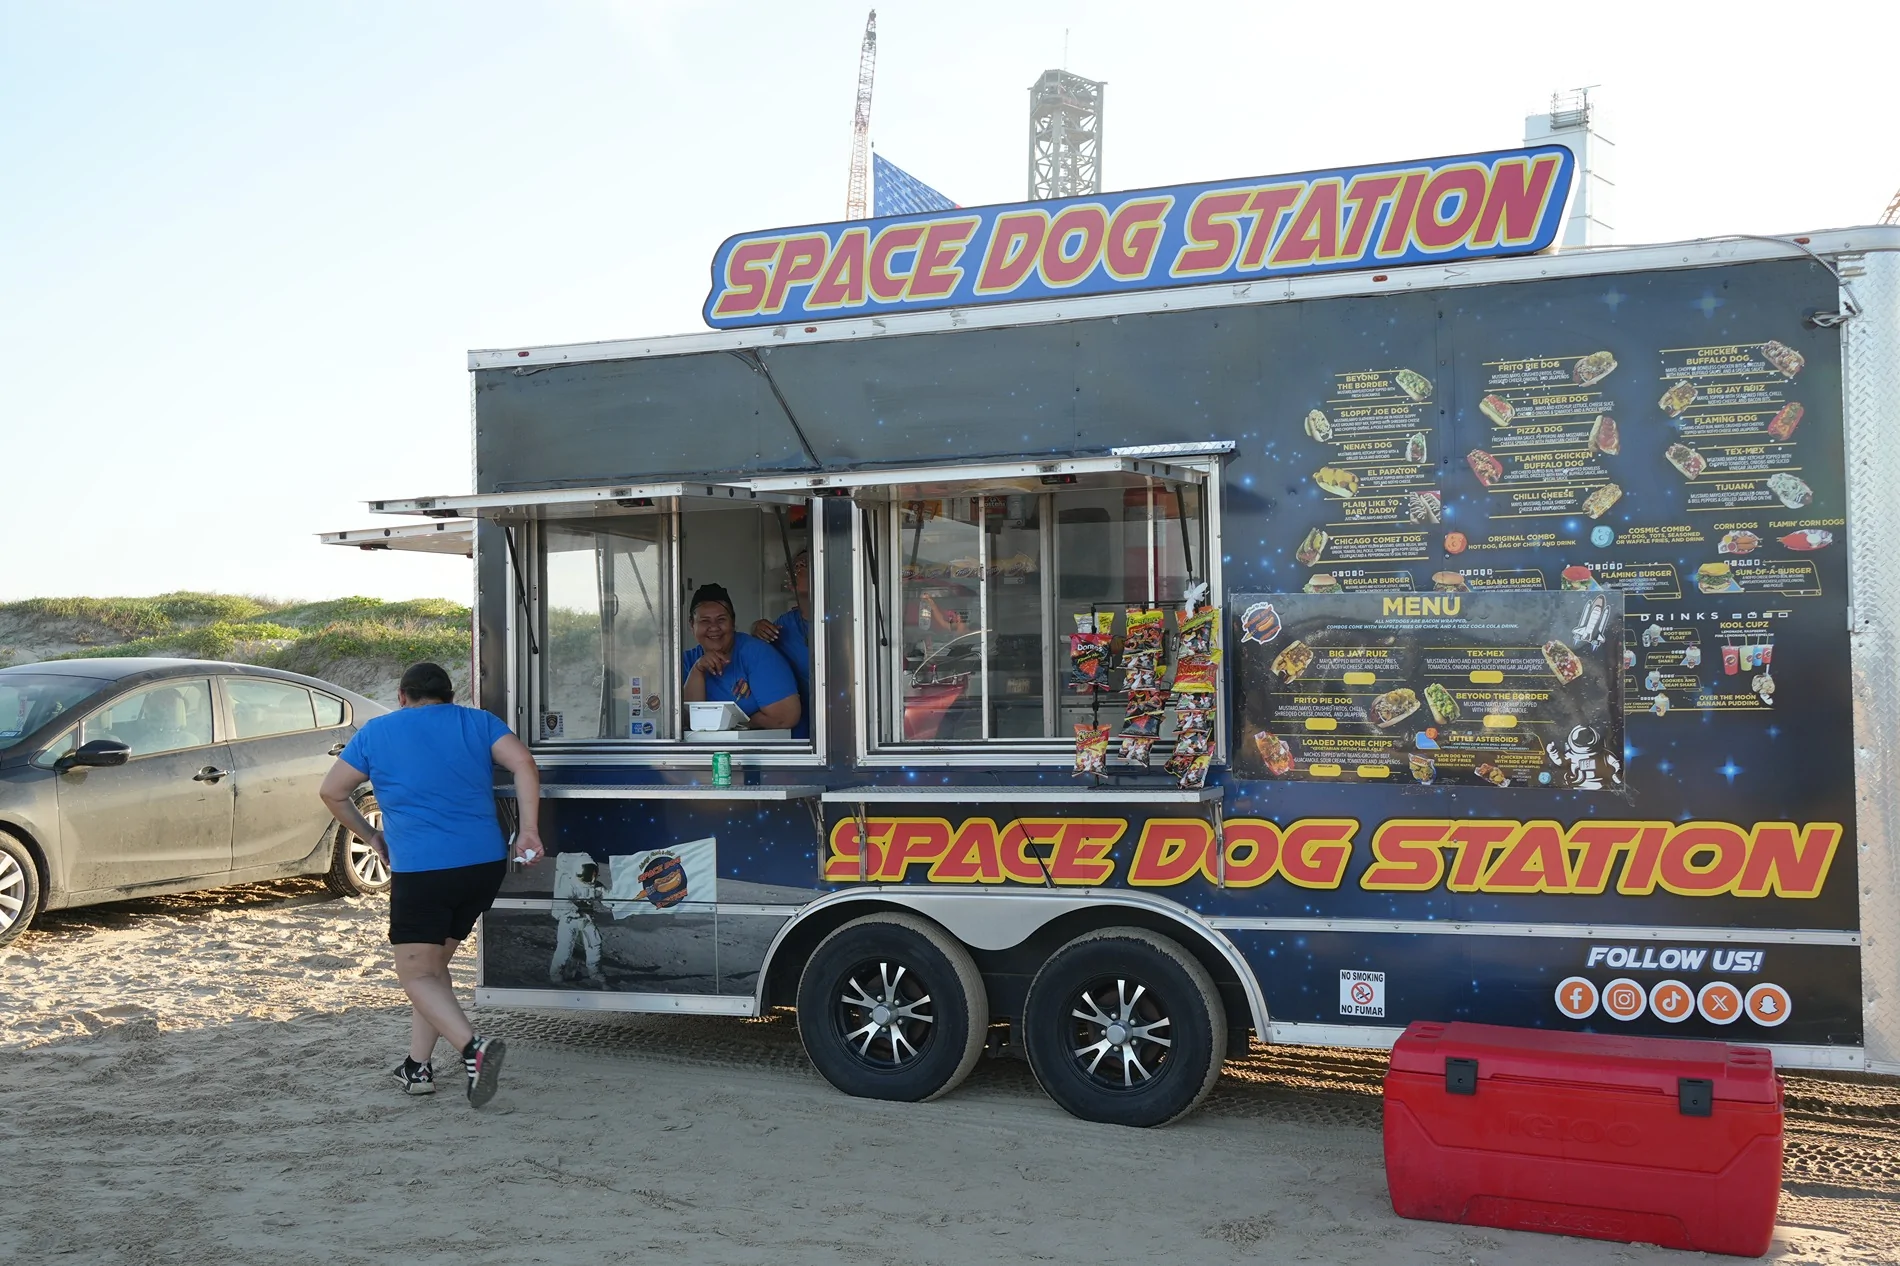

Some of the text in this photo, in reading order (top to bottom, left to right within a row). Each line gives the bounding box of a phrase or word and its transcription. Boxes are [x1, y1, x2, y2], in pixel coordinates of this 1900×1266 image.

[715, 156, 1561, 317] SPACE DOG STATION
[1698, 348, 1738, 356] CHICKEN
[1686, 357, 1727, 365] BUFFALO
[1498, 363, 1523, 371] FRITO
[1346, 374, 1379, 382] BEYOND
[1532, 396, 1567, 405] BURGER
[1340, 409, 1371, 418] SLOPPY
[1373, 408, 1389, 416] JOE
[1694, 416, 1737, 424] FLAMING
[1516, 426, 1541, 434] PIZZA
[1724, 447, 1765, 455] TEX-MEX
[1514, 452, 1592, 462] FLAMING CHICKEN
[1383, 597, 1461, 616] MENU
[1077, 644, 1103, 652] Doritos
[825, 816, 1842, 899] SPACE DOG STATION
[1587, 947, 1765, 973] FOLLOW US!
[1341, 971, 1383, 982] NO SMOKING
[1341, 1005, 1383, 1016] NO FUMAR
[1505, 1110, 1642, 1148] IGLOO
